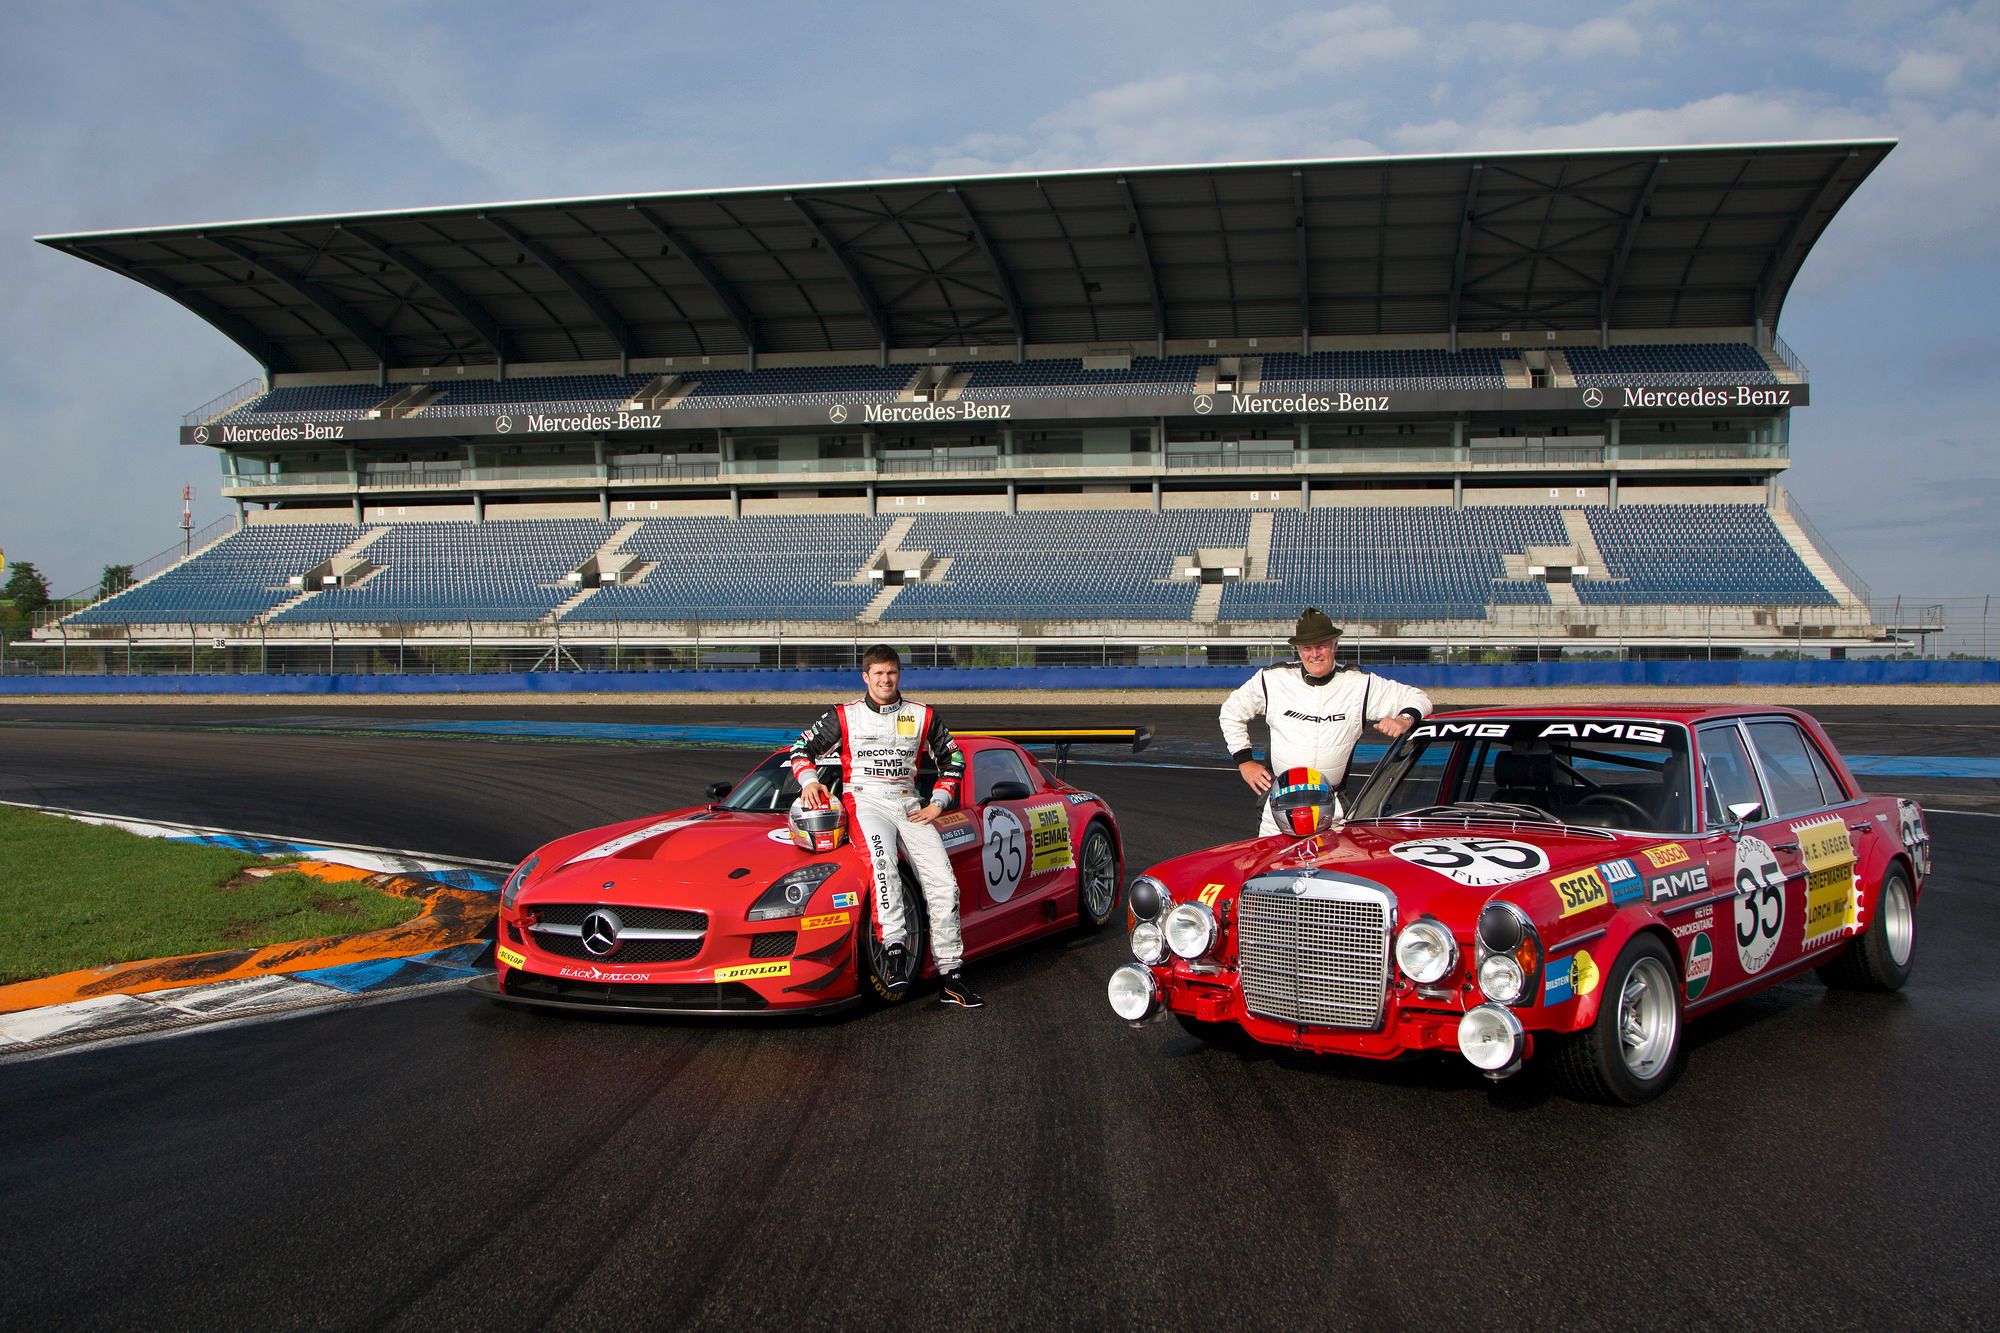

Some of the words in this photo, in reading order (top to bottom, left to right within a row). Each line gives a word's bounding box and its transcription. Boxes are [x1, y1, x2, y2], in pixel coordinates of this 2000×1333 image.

[1231, 392, 1389, 414] Mercedes-Benz
[1623, 386, 1790, 407] Mercedes-Benz
[527, 412, 662, 432] Mercedes-Benz
[863, 401, 1011, 423] Mercedes-Benz
[222, 423, 344, 443] Mercedes-Benz
[1303, 712, 1346, 722] AMG
[1407, 724, 1510, 741] AMG
[1538, 724, 1665, 743] AMG
[857, 748, 914, 758] precote.com
[874, 758, 903, 767] SMS
[864, 767, 910, 777] SIEMAG
[1038, 810, 1060, 827] SMS
[871, 834, 885, 858] SMS
[1034, 827, 1068, 848] SIEMAG
[988, 828, 1023, 886] 35
[1392, 840, 1541, 870] 35
[1654, 845, 1688, 865] BOSCH
[1803, 843, 1822, 862] H.E.
[1821, 835, 1850, 856] SIEGER
[1601, 859, 1637, 883] 100
[877, 872, 890, 910] group
[1559, 873, 1604, 908] SECA
[1652, 868, 1708, 902] AMG
[1736, 861, 1783, 948] 35
[808, 915, 844, 928] DHL
[501, 951, 523, 966] DUNLOP
[559, 968, 592, 979] BLACK
[601, 973, 650, 981] FALCON
[728, 965, 788, 978] DUNLOP
[1545, 975, 1570, 991] BILSTEIN
